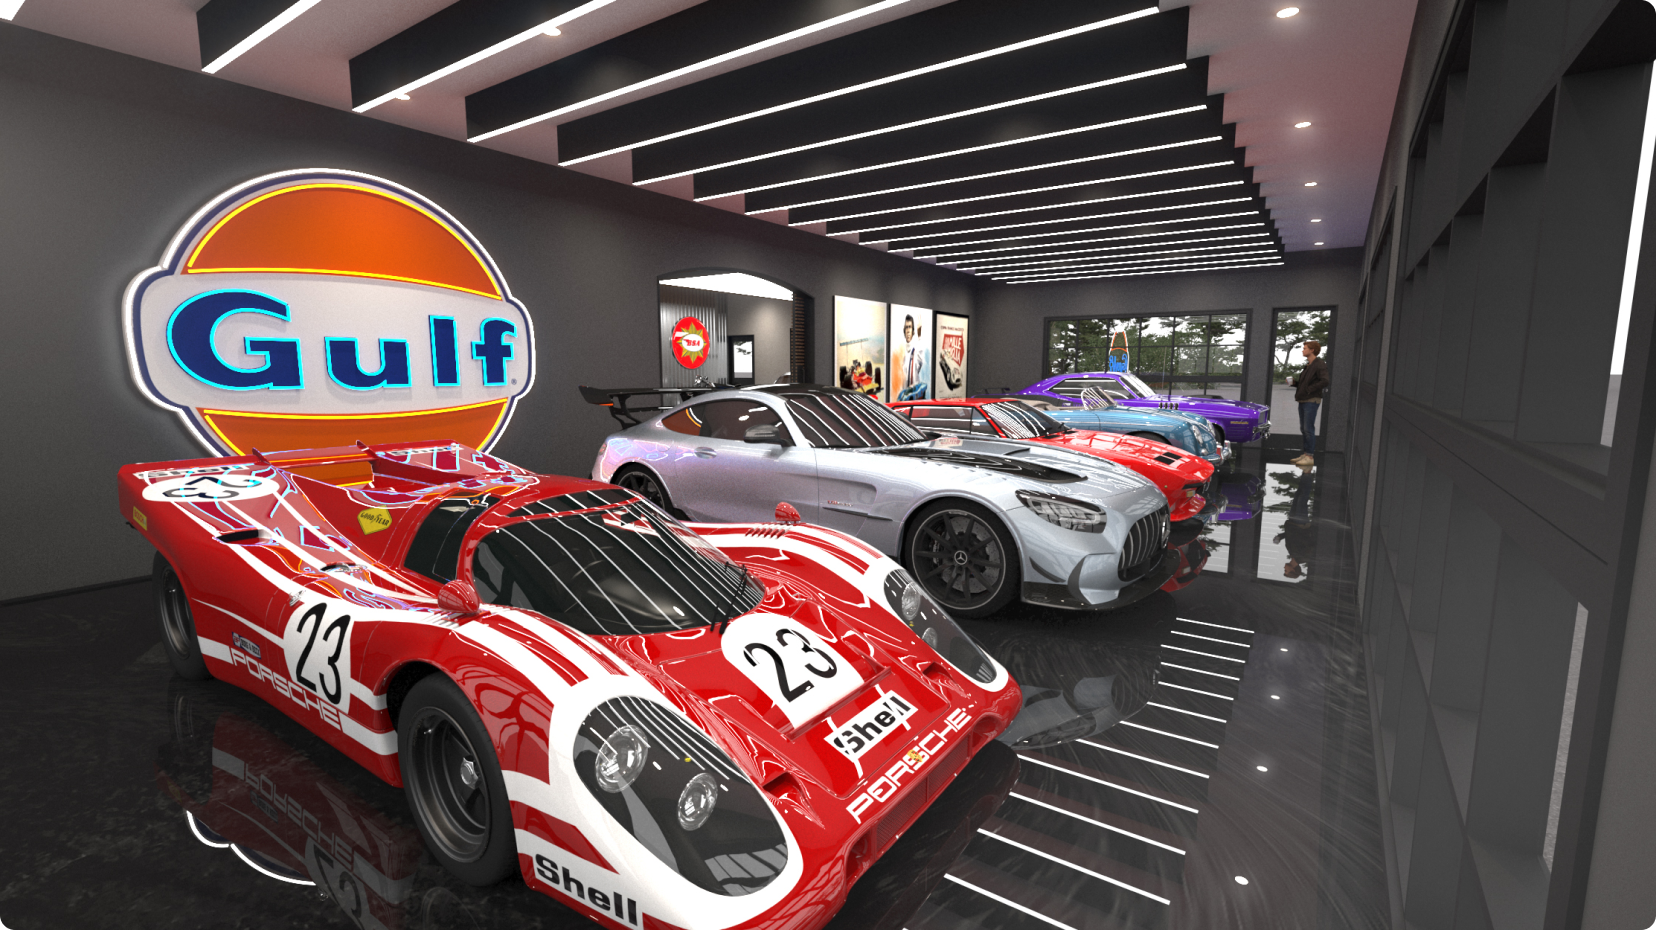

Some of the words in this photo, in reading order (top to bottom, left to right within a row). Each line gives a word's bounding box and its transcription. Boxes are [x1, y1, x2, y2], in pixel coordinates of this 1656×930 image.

[167, 288, 518, 391] Gulf
[686, 339, 701, 347] BSA
[230, 647, 342, 731] PORSCHE
[296, 602, 351, 705] 23
[743, 628, 837, 703] 23
[833, 696, 911, 755] Shell
[846, 707, 972, 825] PORSCHE
[535, 853, 638, 927] Shell
